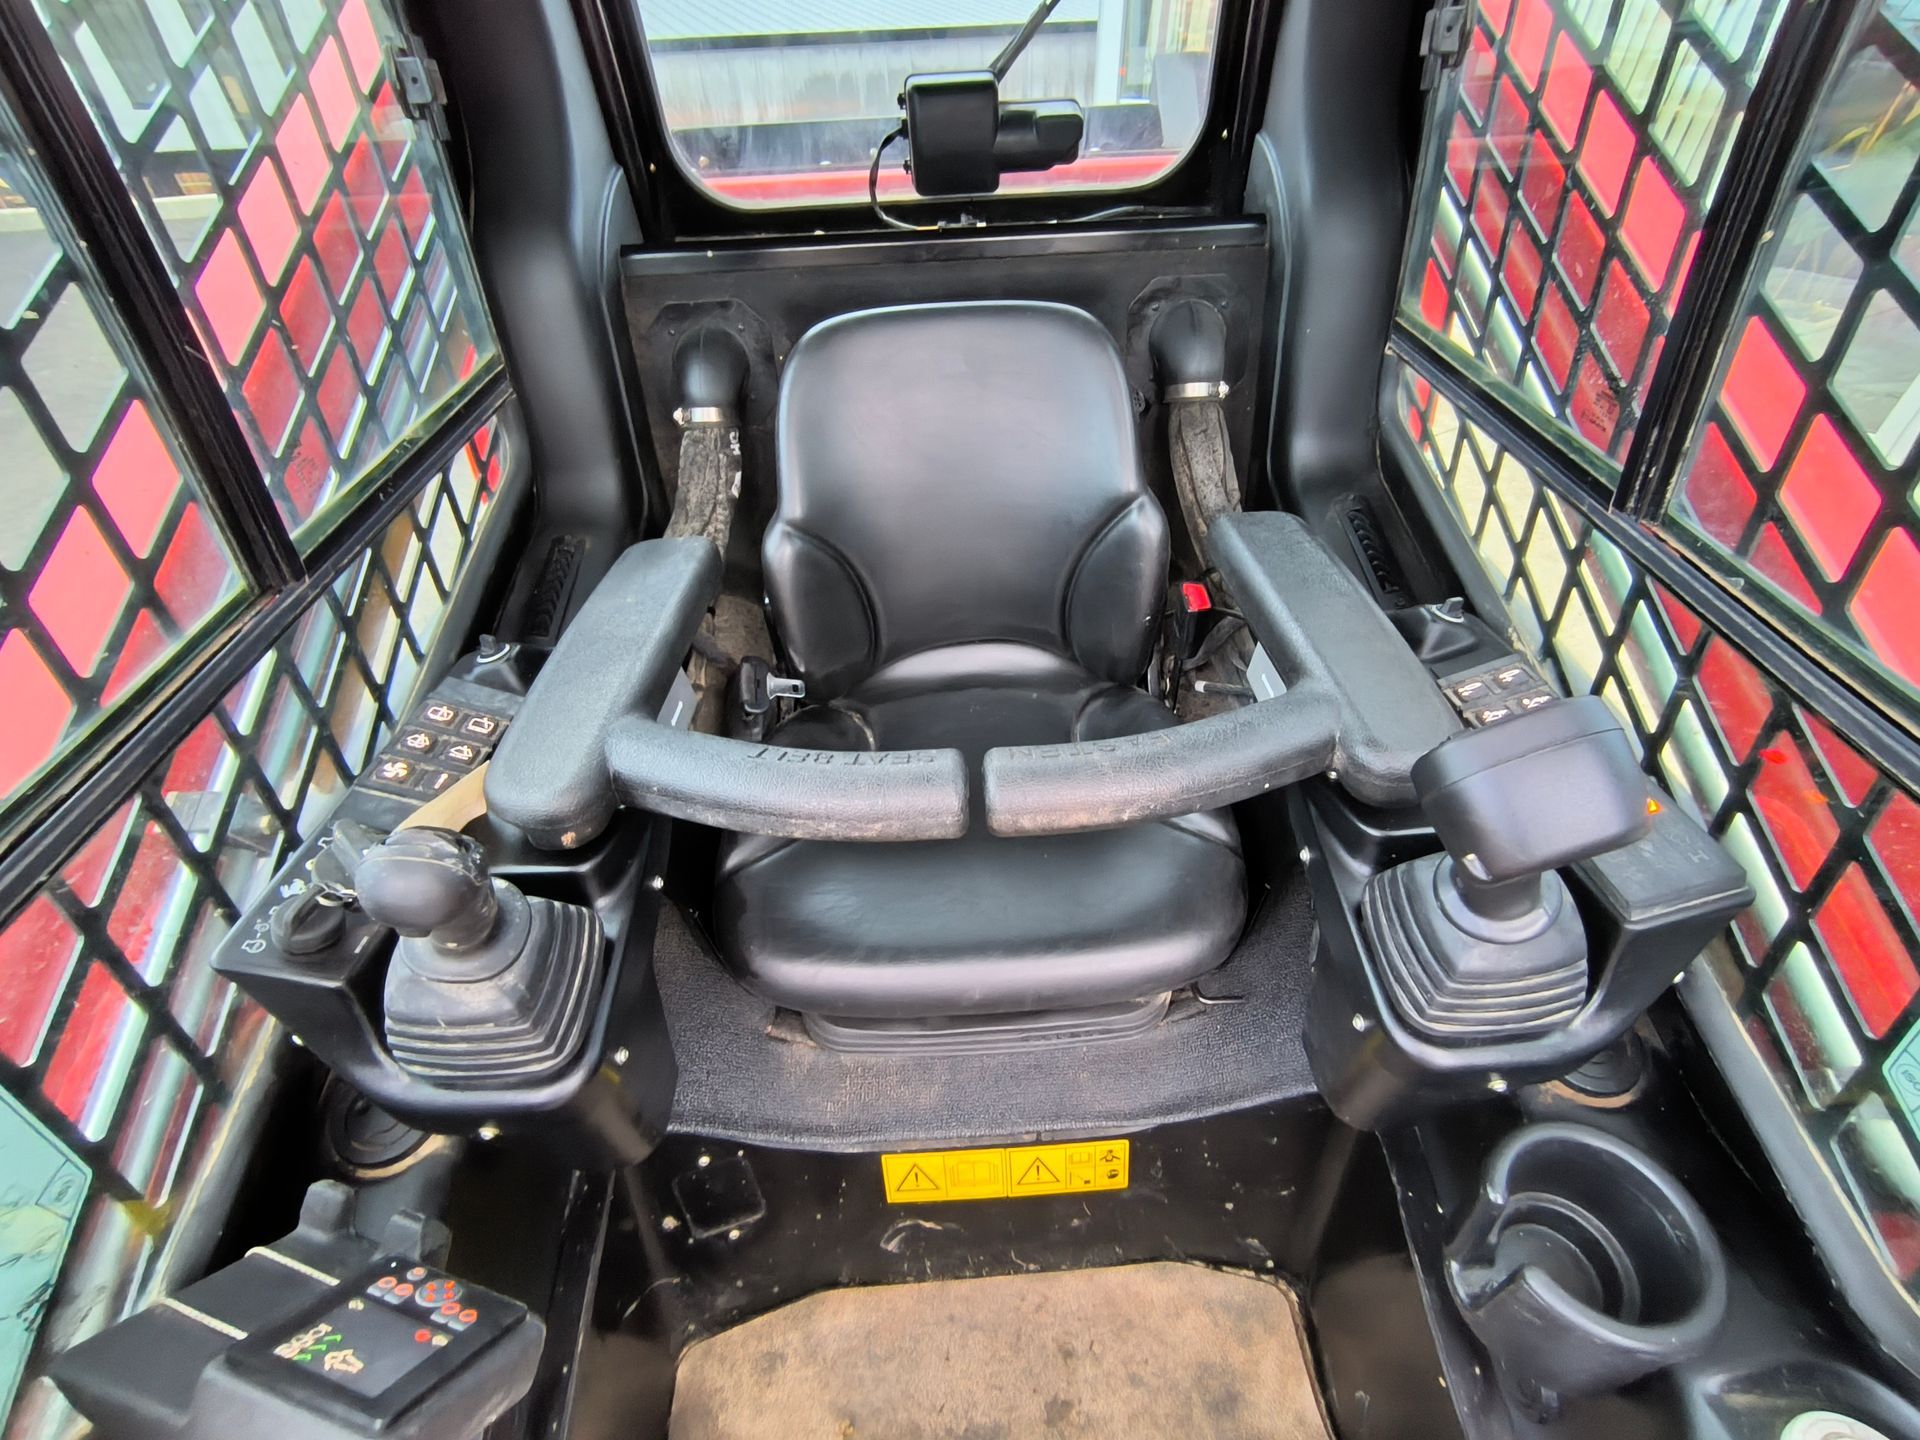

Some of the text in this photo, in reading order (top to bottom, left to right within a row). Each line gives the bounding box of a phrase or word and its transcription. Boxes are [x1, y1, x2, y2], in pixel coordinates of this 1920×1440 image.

[746, 747, 936, 767] SEAT BELT
[1009, 732, 1172, 759] FASTEN
